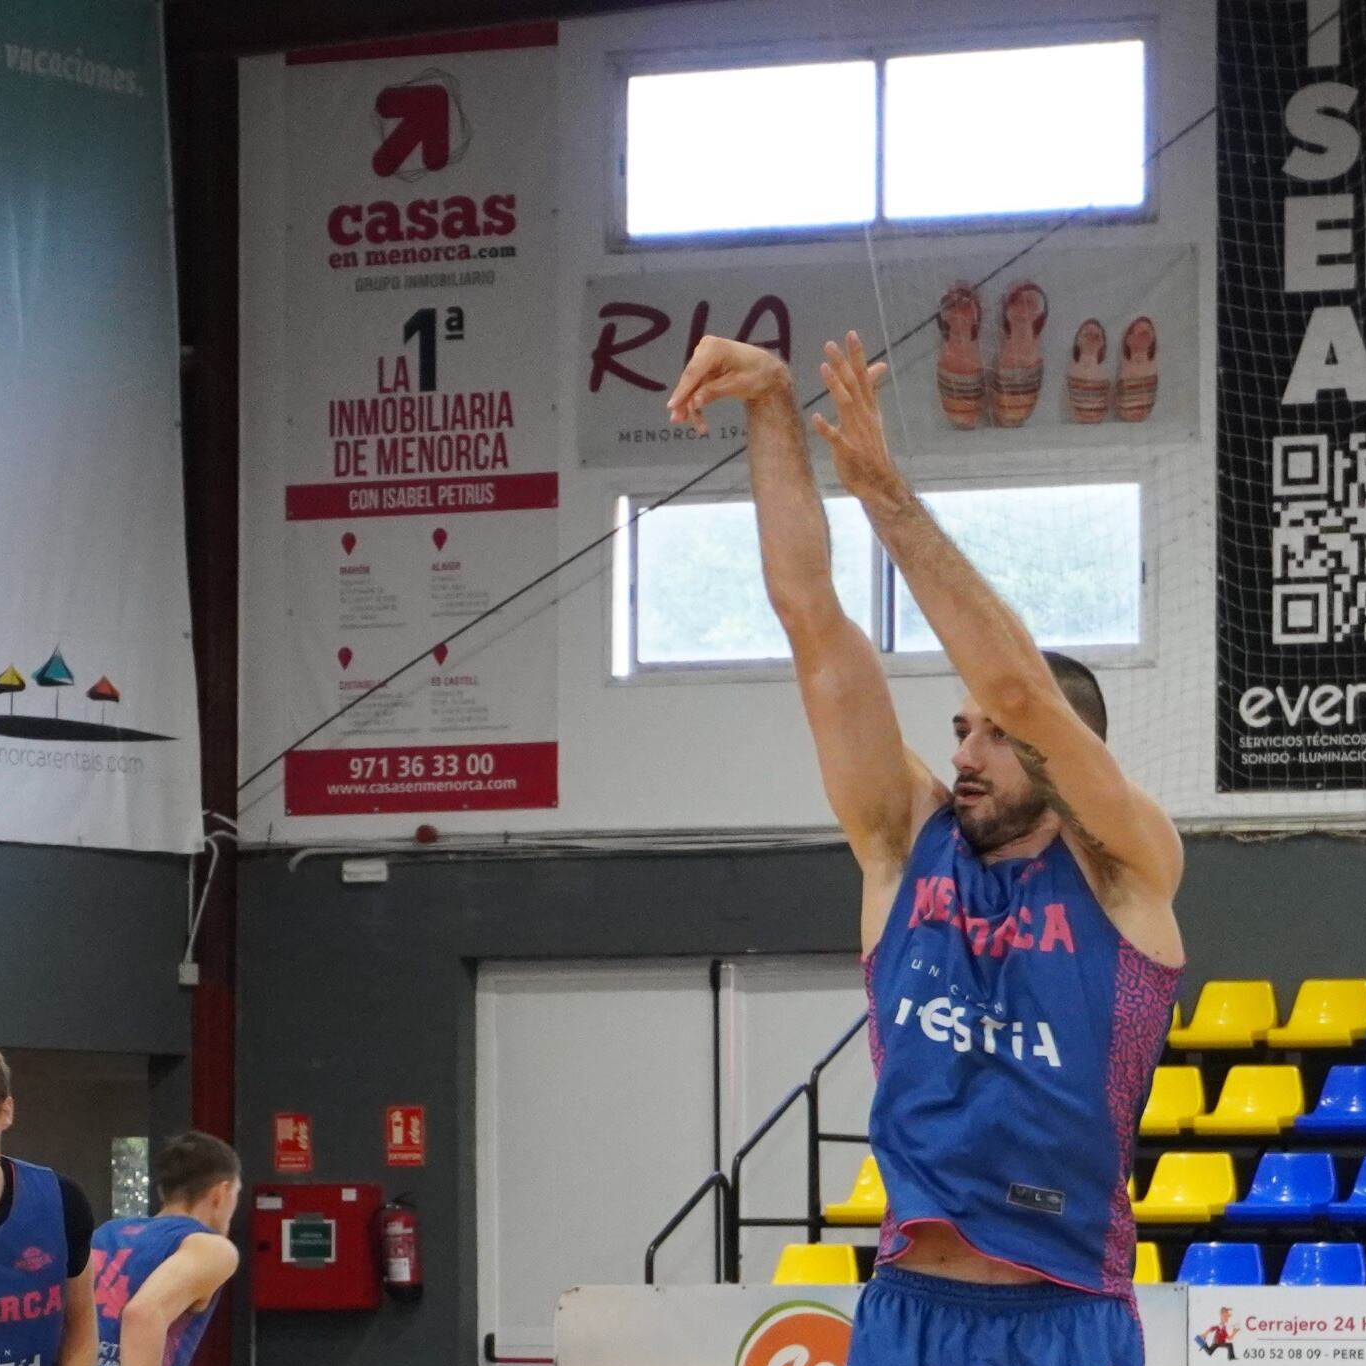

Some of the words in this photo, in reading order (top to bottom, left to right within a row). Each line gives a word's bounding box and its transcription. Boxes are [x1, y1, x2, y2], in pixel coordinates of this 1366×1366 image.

[327, 194, 517, 246] casas
[329, 250, 359, 270] en
[378, 356, 411, 394] LA
[328, 391, 514, 437] INMOBILIARIA
[334, 440, 368, 477] DE
[376, 432, 509, 476] MENORCA
[348, 488, 380, 511] CON
[382, 485, 434, 510] ISABEL
[437, 483, 495, 507] PETRUS
[1239, 735, 1303, 749] SERVICIOS
[348, 758, 389, 779] 971
[397, 756, 424, 779] 36
[432, 754, 459, 777] 33
[466, 753, 494, 775] 00
[1241, 751, 1290, 765] SONIDO
[327, 776, 517, 796] www.casasenmenorca.com
[1245, 1316, 1327, 1335] Cerrajero
[1334, 1316, 1355, 1331] 24
[1243, 1348, 1265, 1359] 630
[1269, 1348, 1283, 1359] 52
[1288, 1348, 1302, 1359] 08
[1306, 1348, 1321, 1359] 09
[1333, 1349, 1365, 1360] PERE
